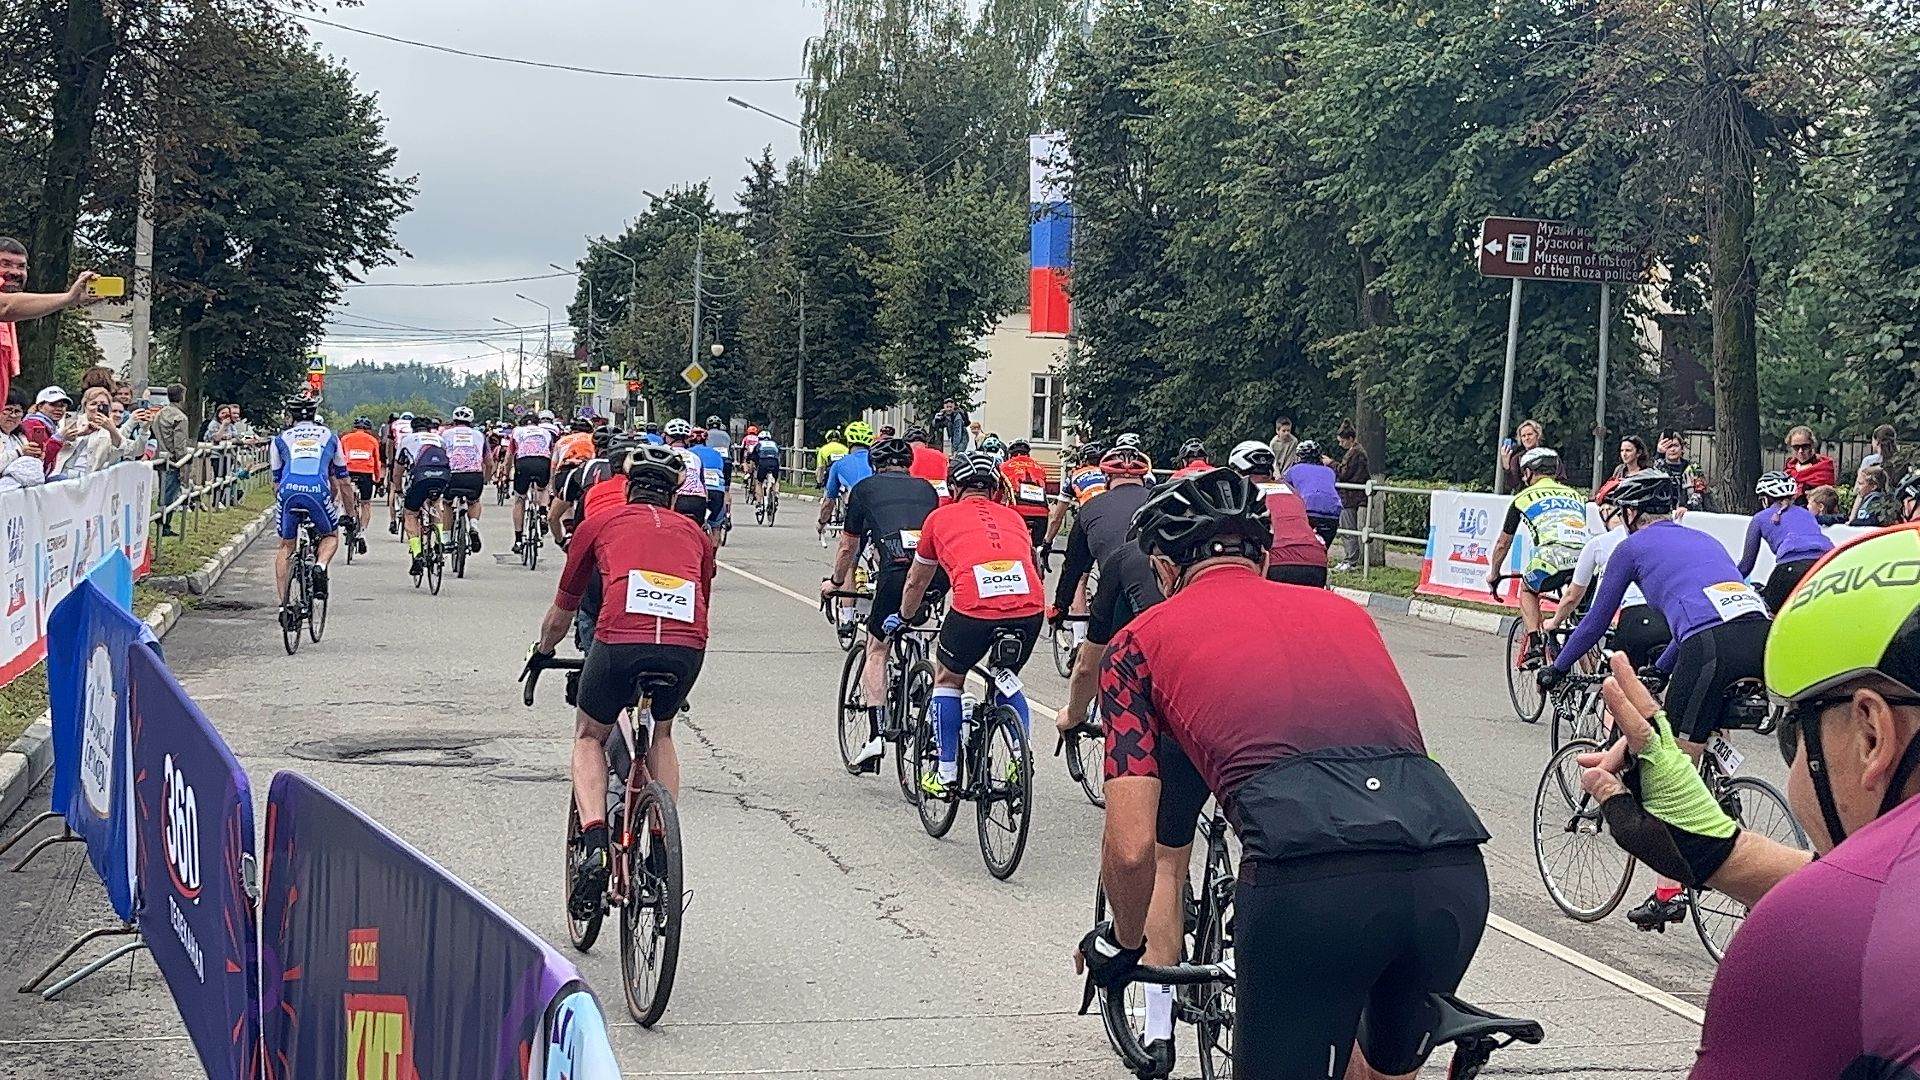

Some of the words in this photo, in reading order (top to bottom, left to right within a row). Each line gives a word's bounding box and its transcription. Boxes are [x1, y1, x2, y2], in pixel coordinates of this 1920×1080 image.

[1537, 222, 1574, 237] Музй
[1536, 235, 1584, 251] Рузской
[1534, 250, 1582, 265] Museum
[1584, 256, 1596, 265] of
[1534, 265, 1547, 277] of
[1550, 265, 1570, 278] the
[1573, 265, 1601, 280] Ruza
[1604, 268, 1640, 282] police
[285, 483, 322, 493] nem.nl
[1539, 499, 1582, 511] SAXO
[982, 574, 1022, 585] 2045
[636, 588, 687, 606] 2072
[1713, 737, 1733, 762] 2036
[164, 752, 200, 889] 360
